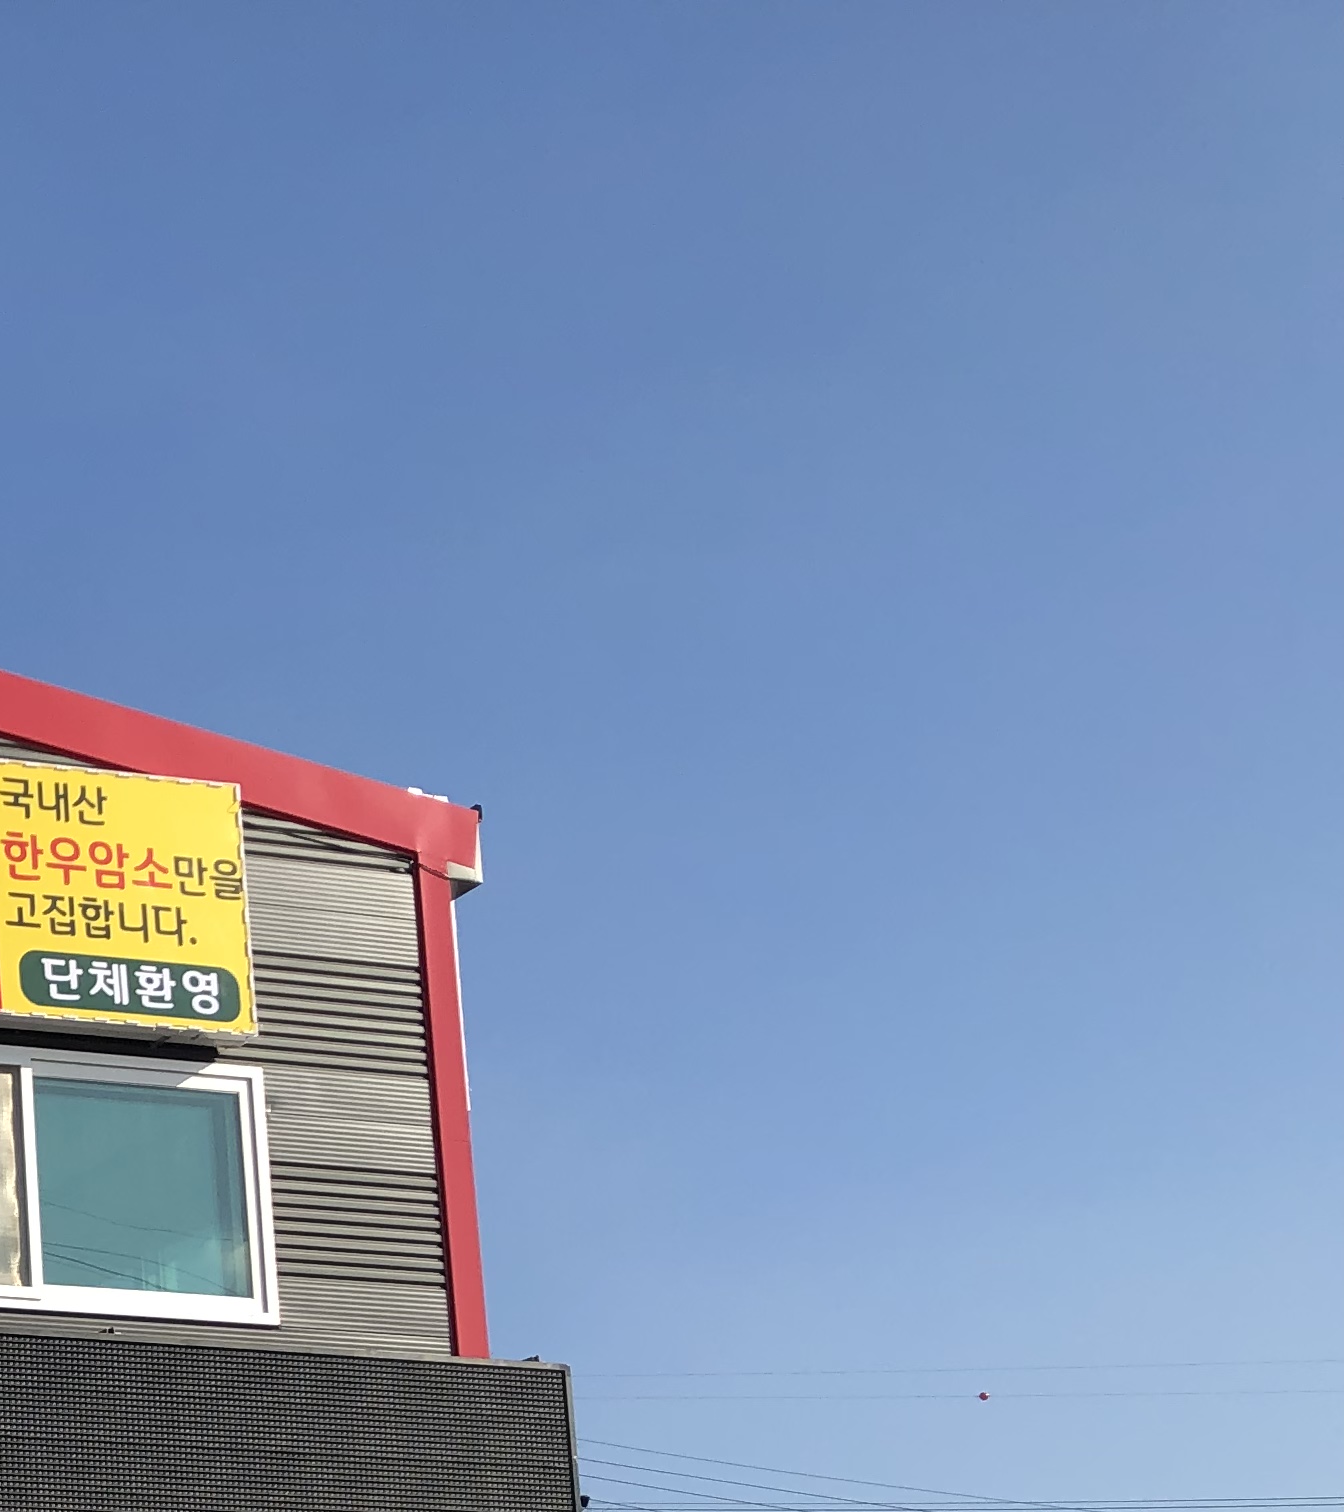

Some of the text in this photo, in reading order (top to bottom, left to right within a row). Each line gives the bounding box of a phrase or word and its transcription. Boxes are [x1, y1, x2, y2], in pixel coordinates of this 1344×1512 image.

[0, 777, 107, 826] 국내산
[1, 829, 241, 900] 한우암소만을
[5, 891, 198, 947] 고집합니다.
[41, 958, 222, 1013] 단체환영
